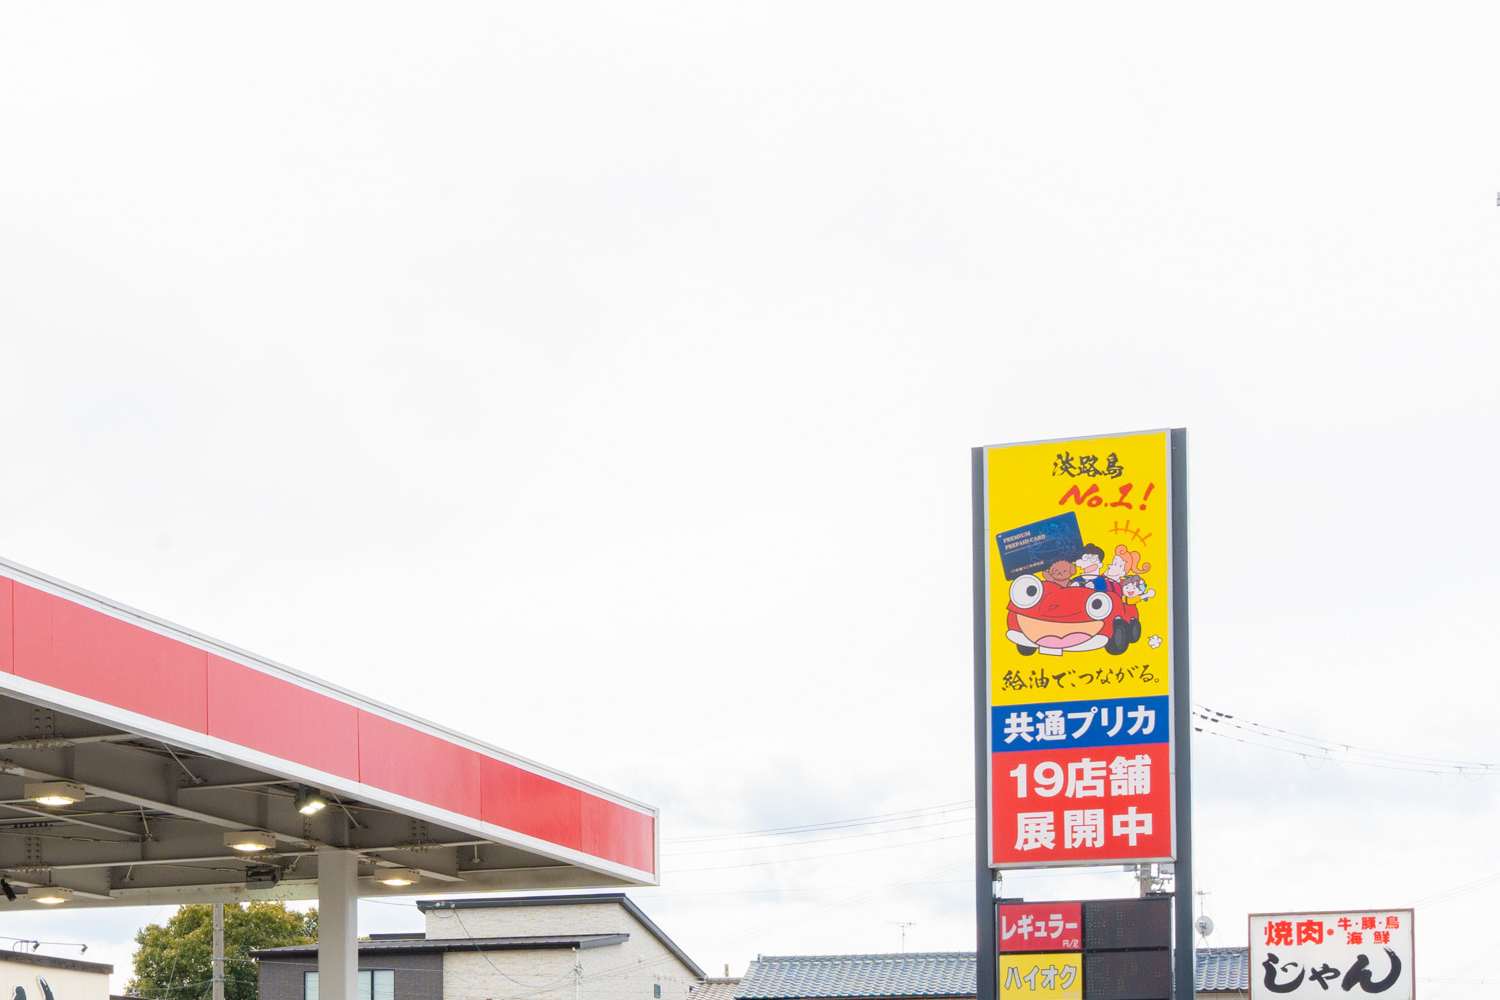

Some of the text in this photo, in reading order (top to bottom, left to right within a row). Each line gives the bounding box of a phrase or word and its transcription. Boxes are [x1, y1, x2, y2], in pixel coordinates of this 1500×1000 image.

[1052, 451, 1124, 479] 淡路島
[1058, 482, 1155, 511] No.1!
[1003, 531, 1031, 543] PREMIUM
[1005, 534, 1046, 550] PREPAID CARD
[1004, 705, 1157, 743] 共通プリカ
[1009, 754, 1152, 798] 19店舗
[1014, 806, 1153, 851] 展開中
[1001, 913, 1077, 940] レギュラー
[1004, 964, 1077, 991] ハイオク
[1262, 946, 1402, 993] じゃん
